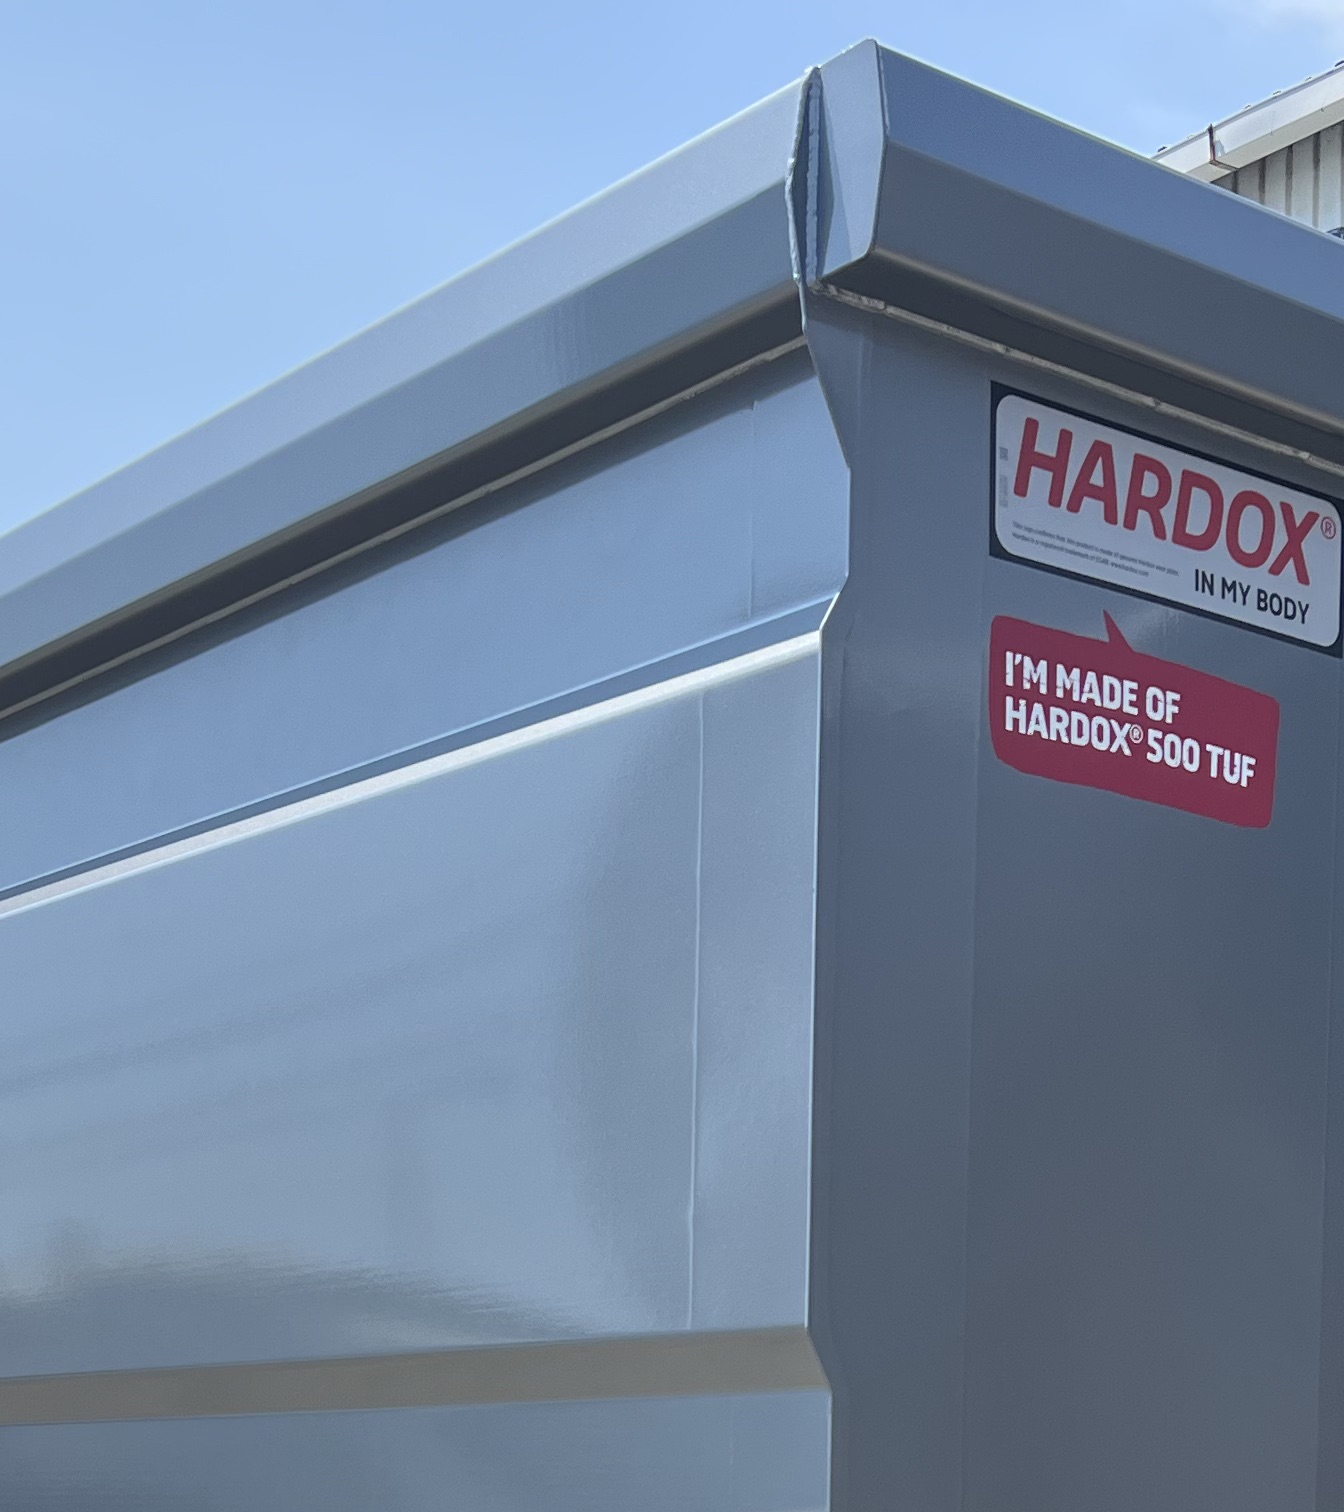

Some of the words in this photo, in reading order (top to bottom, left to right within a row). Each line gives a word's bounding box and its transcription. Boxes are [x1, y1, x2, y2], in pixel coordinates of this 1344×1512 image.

[1194, 568, 1215, 597] IN
[1221, 577, 1251, 606] MY
[1256, 588, 1309, 624] BODY
[1055, 663, 1139, 716] MADE
[1145, 686, 1181, 724] OF
[1146, 728, 1201, 773] 500
[1205, 743, 1256, 788] TUF
